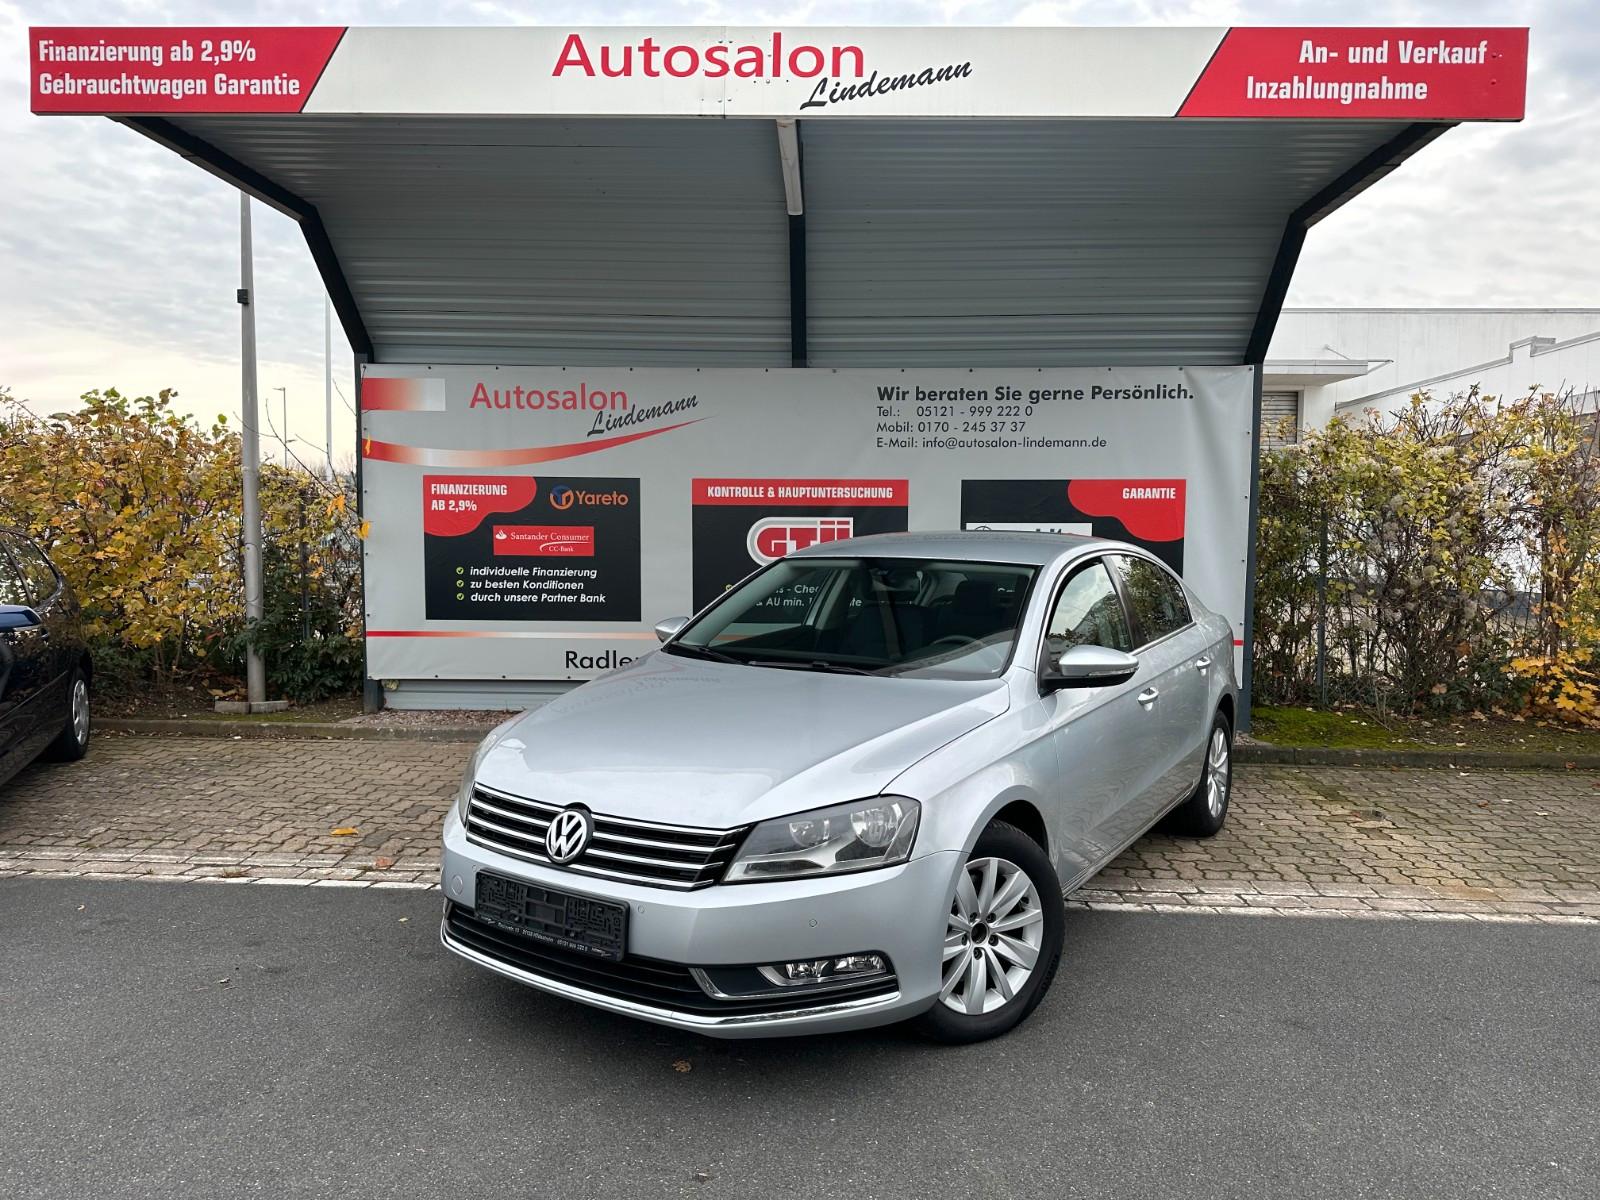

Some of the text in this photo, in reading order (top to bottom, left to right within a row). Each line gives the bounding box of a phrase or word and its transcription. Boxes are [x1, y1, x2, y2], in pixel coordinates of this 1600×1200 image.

[39, 40, 256, 66] Finanzierung ab 2,9%
[552, 32, 863, 77] Autosalon
[1299, 40, 1487, 64] An- und Verkauf
[40, 73, 299, 99] Gebrauchtwagen Garantie
[799, 60, 973, 110] Lindemann
[1247, 76, 1427, 104] Inzahlungnahme
[470, 383, 627, 410] Autosalon
[877, 384, 1193, 404] Wir beraten Sie gerne Persönlich.
[587, 394, 698, 437] Lindemann
[876, 405, 900, 417] Tel.:
[916, 405, 954, 417] 05121
[969, 405, 993, 417] 999
[996, 405, 1020, 417] 222
[1024, 405, 1033, 417] 0
[876, 421, 914, 433] Mobil:
[917, 421, 950, 433] 0170
[962, 421, 986, 433] 245
[990, 421, 1006, 433] 37
[1010, 421, 1026, 433] 37
[876, 436, 1106, 449] E-Mail: info@autosalon-lindemann.de
[431, 483, 508, 496] FINANZIERUNG
[707, 486, 893, 499] KONTROLLE & HAUPTUNTERSUCHUNG
[1122, 487, 1176, 500] GARANTIE
[576, 491, 628, 505] Yareto
[431, 499, 477, 512] AB 2,9%
[510, 531, 590, 543] Santander Consumer
[470, 566, 598, 579] individuelle Finanzierung
[470, 579, 584, 590] zu besten Konditionen
[470, 592, 606, 603] durch unsere Partner Bank
[765, 597, 781, 607] AU
[782, 597, 805, 607] min.
[566, 650, 639, 670] Radle
